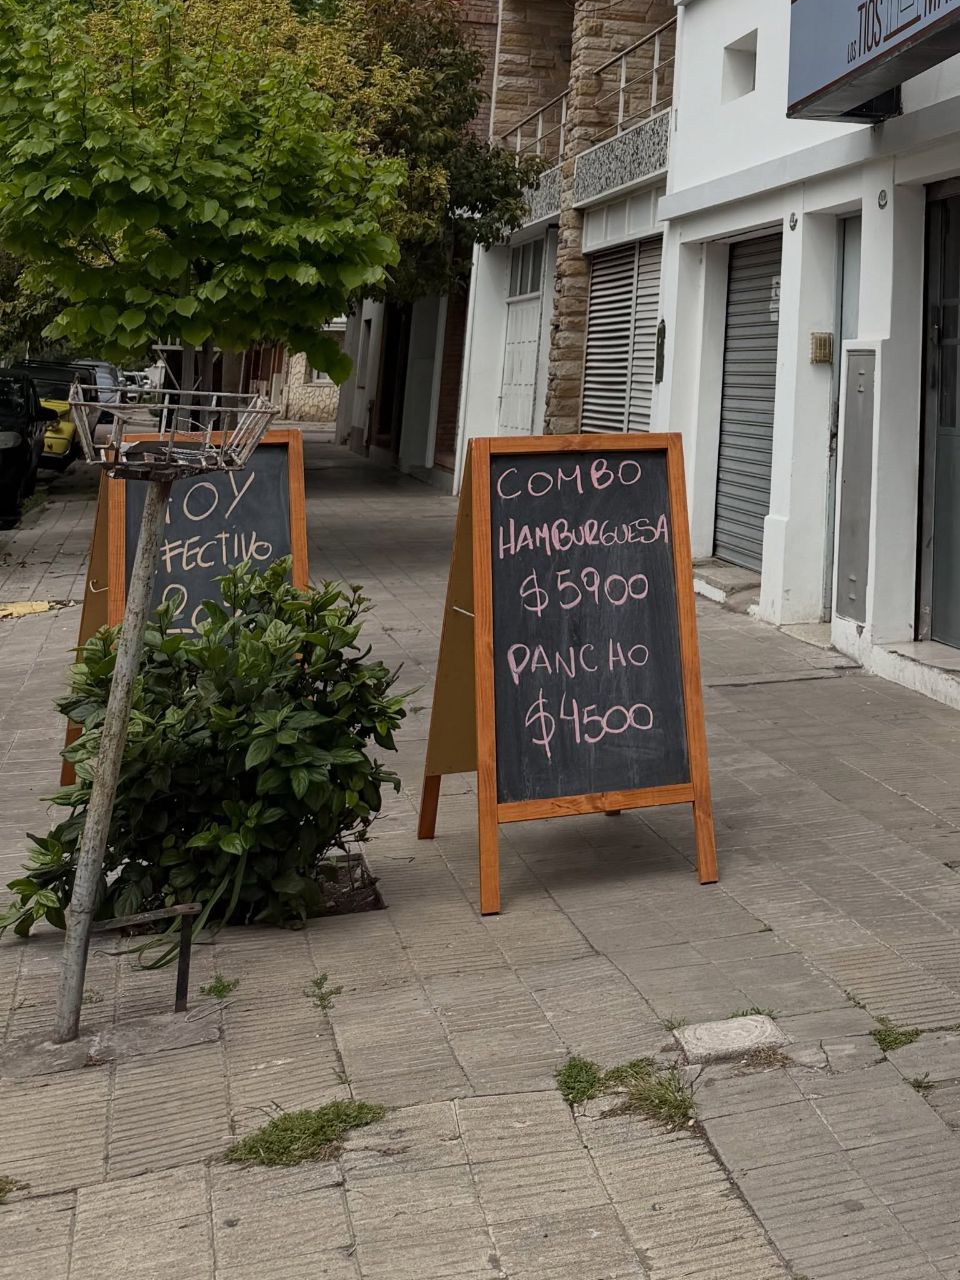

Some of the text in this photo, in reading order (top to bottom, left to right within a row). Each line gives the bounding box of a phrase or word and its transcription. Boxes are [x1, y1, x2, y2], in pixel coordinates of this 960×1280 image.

[497, 458, 641, 499] COMBO
[157, 525, 272, 573] FECTIVO
[499, 514, 669, 559] HAMBURGUESA
[507, 639, 649, 685] PANCHO
